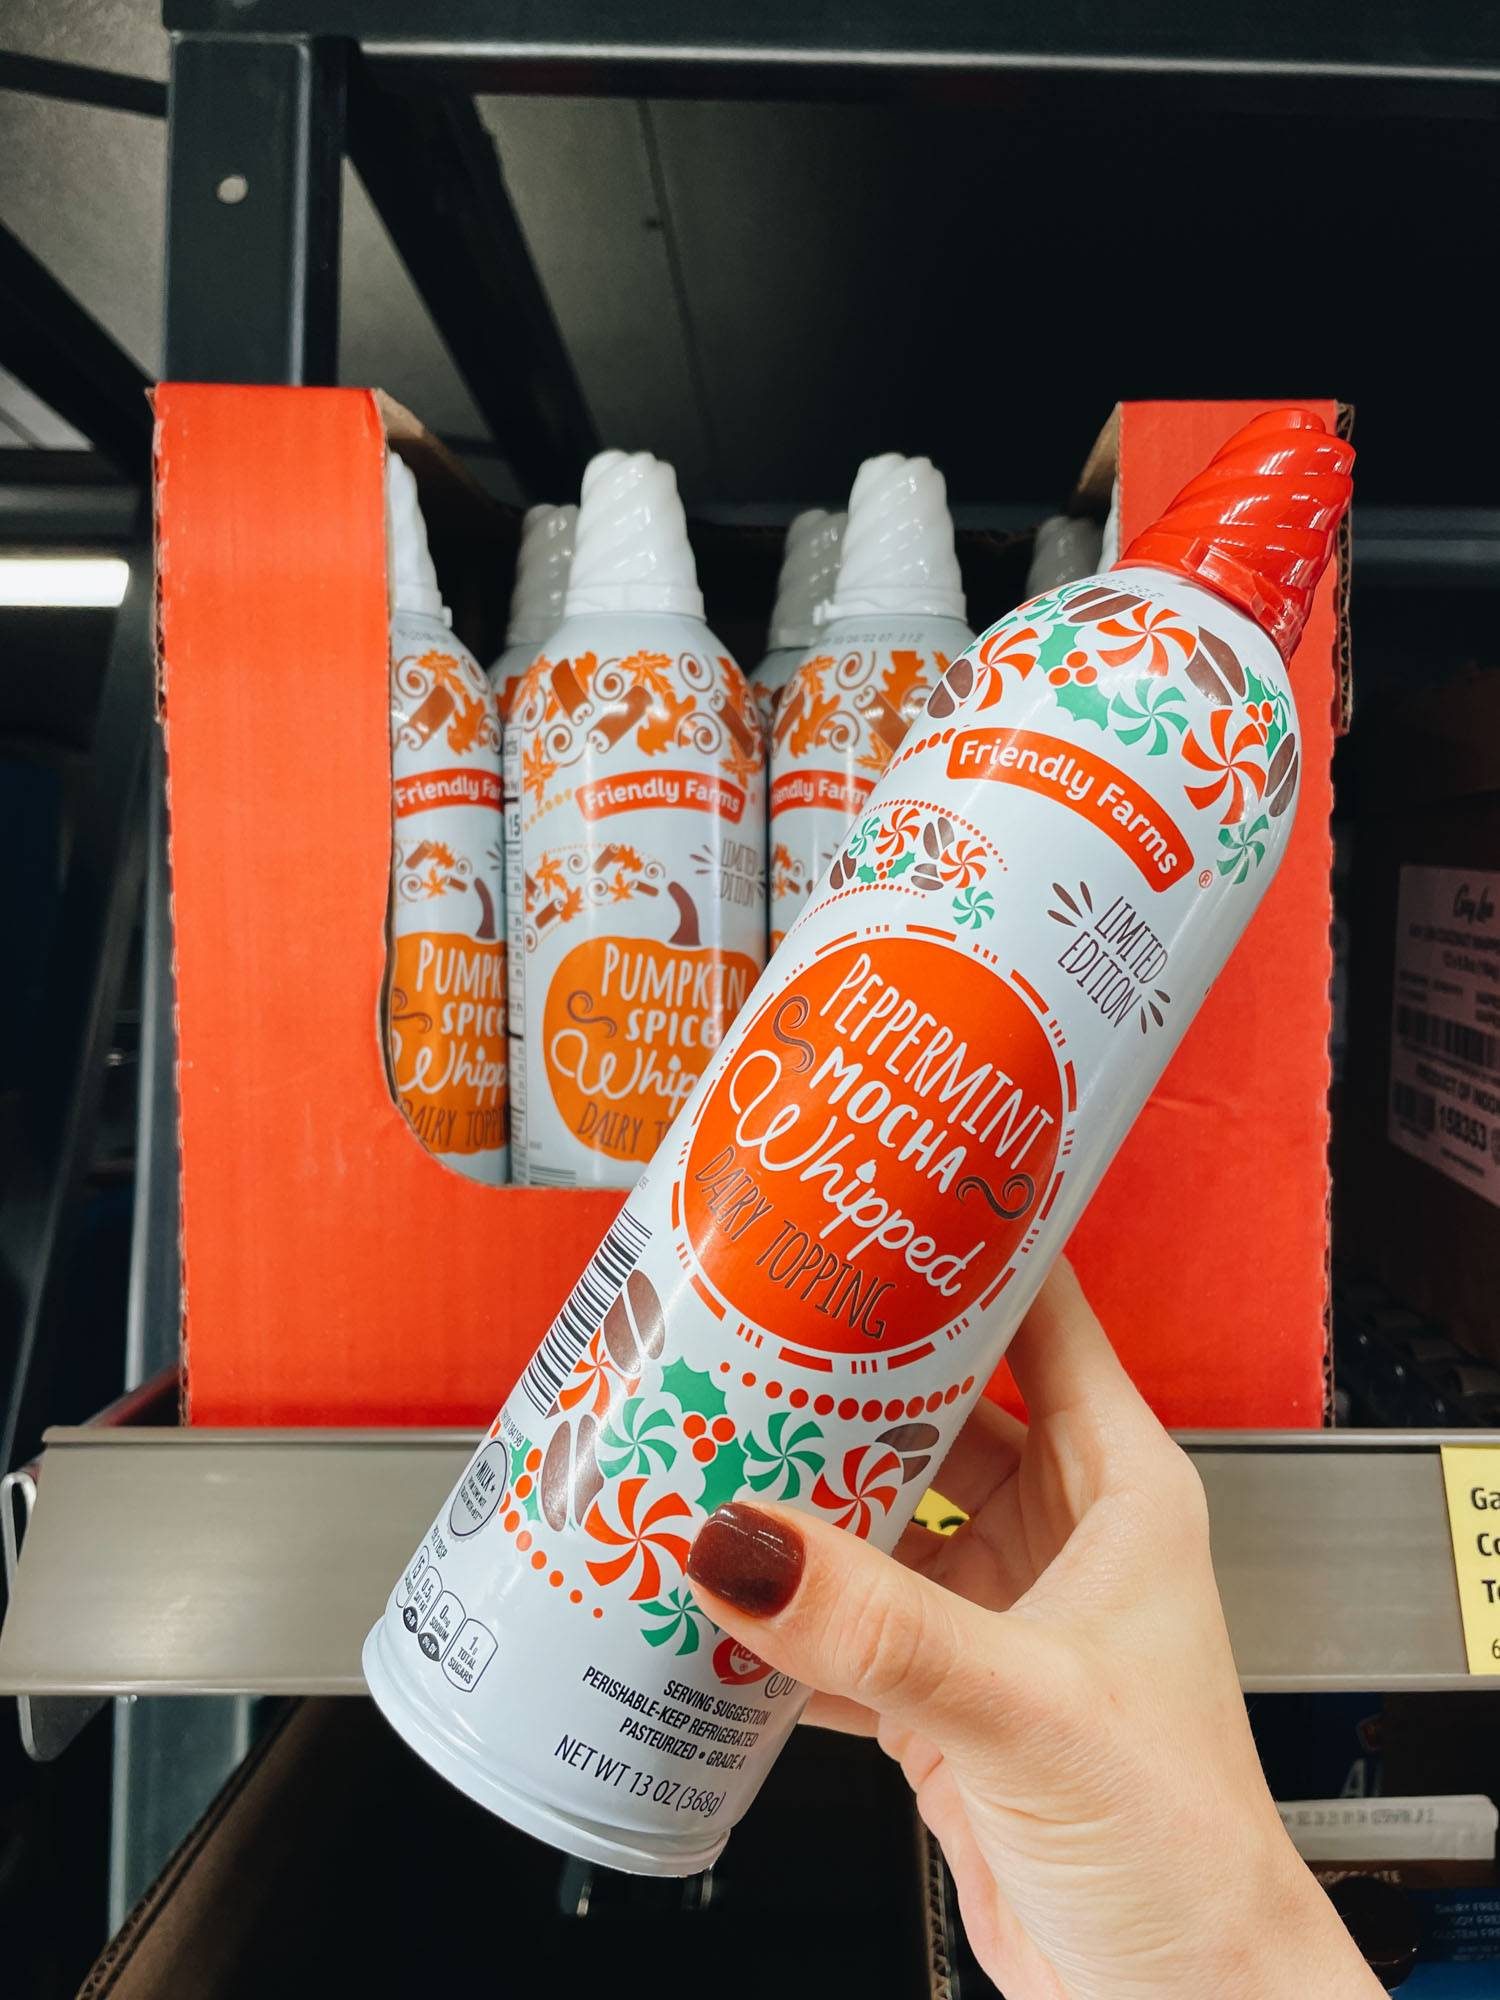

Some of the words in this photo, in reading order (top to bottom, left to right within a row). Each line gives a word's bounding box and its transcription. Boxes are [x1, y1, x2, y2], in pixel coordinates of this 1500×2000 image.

[394, 775, 479, 808] Friendly
[586, 777, 679, 811] Friendly
[685, 779, 740, 813] Farms
[959, 740, 1095, 801] Friendly
[1097, 783, 1178, 875] Farms
[1094, 896, 1168, 984] LIMITED
[601, 943, 747, 1011] PUMPKIN
[1057, 931, 1142, 1028] EDITION
[626, 1008, 723, 1049] SPICE
[820, 953, 1053, 1170] PEPPERMINT
[577, 1102, 643, 1154] DAIRY
[809, 1046, 967, 1194] MOCHA
[729, 1050, 985, 1297] Whipped
[694, 1145, 774, 1240] DAIRY
[756, 1220, 896, 1340] TOPPING
[429, 1616, 450, 1643] SODIUM
[456, 1646, 477, 1670] TOTAL
[447, 1657, 473, 1685] SUGARS
[663, 1680, 712, 1713] SERVING
[712, 1699, 772, 1726] SUGGESTION
[582, 1666, 690, 1728] PERISHABLE-KEEP
[689, 1718, 760, 1748] REFRIGERATED
[554, 1734, 598, 1772] NET
[594, 1753, 631, 1787] WT
[629, 1772, 654, 1797] 13
[653, 1780, 680, 1806] OZ
[676, 1786, 726, 1817] (368g)
[619, 1717, 698, 1760] PASTEURIZED
[706, 1750, 735, 1769] GRADE
[734, 1756, 746, 1770] A
